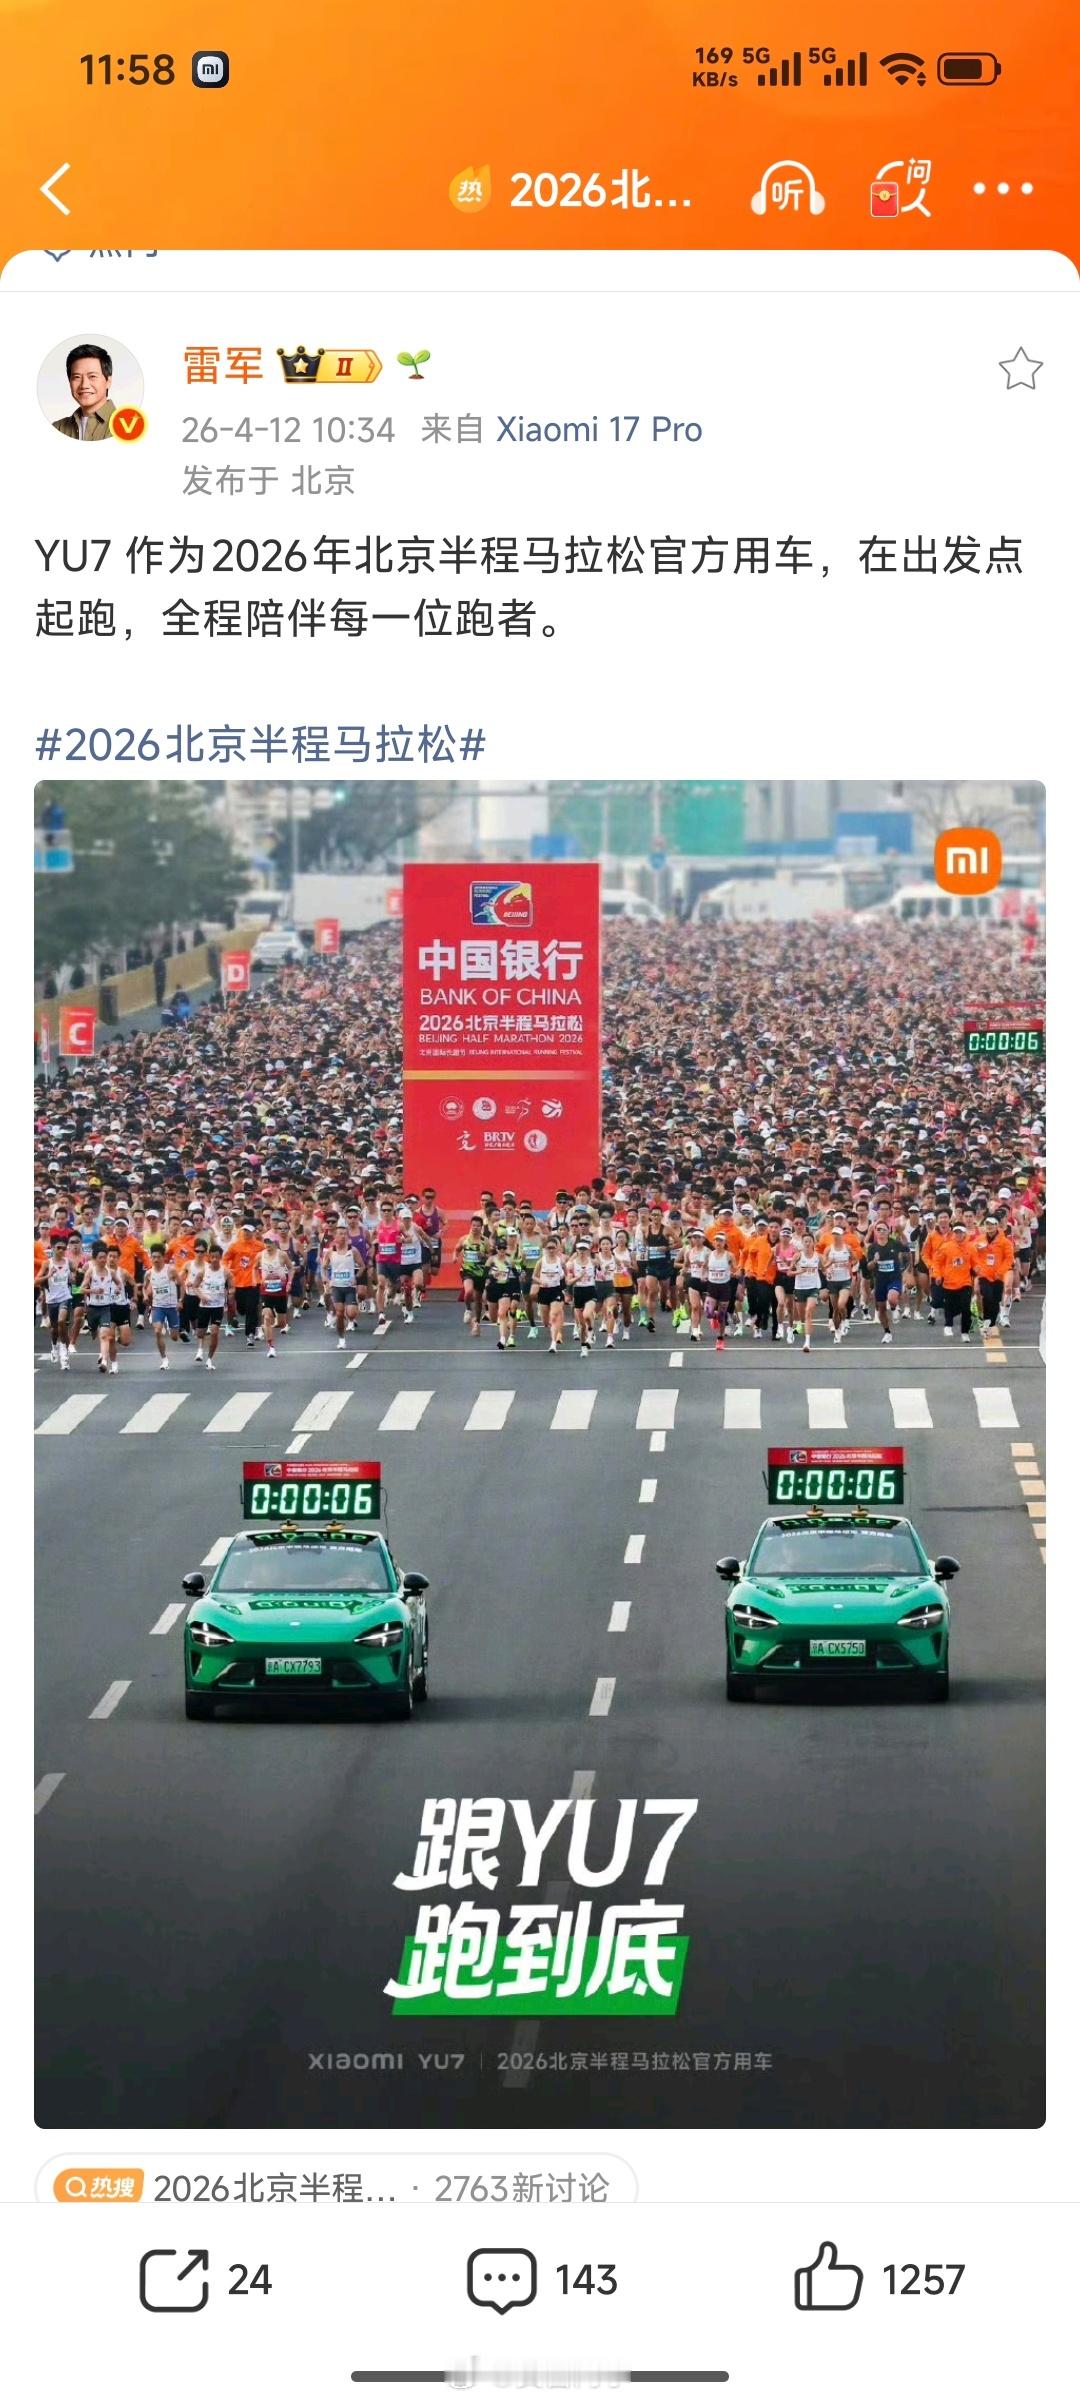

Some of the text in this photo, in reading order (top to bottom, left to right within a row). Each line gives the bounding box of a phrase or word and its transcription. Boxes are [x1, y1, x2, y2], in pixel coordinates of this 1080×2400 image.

[80, 53, 175, 85] 11:58
[695, 47, 733, 64] 169
[742, 47, 770, 64] 5G
[808, 47, 836, 64] 5G
[692, 71, 738, 87] KB/s
[457, 179, 482, 202] 热
[772, 179, 804, 211] 听
[183, 346, 264, 385] 雷军
[181, 416, 396, 443] 26-4-12 10:34
[421, 412, 703, 444] 来自 Xiaomi 17 Pro
[182, 464, 355, 496] 发布于 北京
[34, 539, 112, 573] YU7
[34, 597, 557, 641] 起跑，全程陪伴每一位跑者。
[34, 723, 487, 764] #2026北京半程马拉松#
[227, 964, 244, 982] D
[418, 938, 584, 981] 中国银行
[420, 988, 582, 1005] BANK OF CHINA
[68, 1022, 87, 1046] C
[418, 1034, 583, 1043] BEIJING HALF MARATHON 2026
[419, 1014, 583, 1032] 2026北京半程马拉松
[969, 1032, 1038, 1051] 0:00:06
[251, 1483, 372, 1514] 0:00:06
[776, 1470, 895, 1500] 0:00:06
[91, 2176, 134, 2198] 热搜
[435, 2171, 611, 2202] 2763新讨论
[228, 2263, 273, 2295] 24
[556, 2263, 618, 2296] 143
[883, 2263, 966, 2296] 1257
